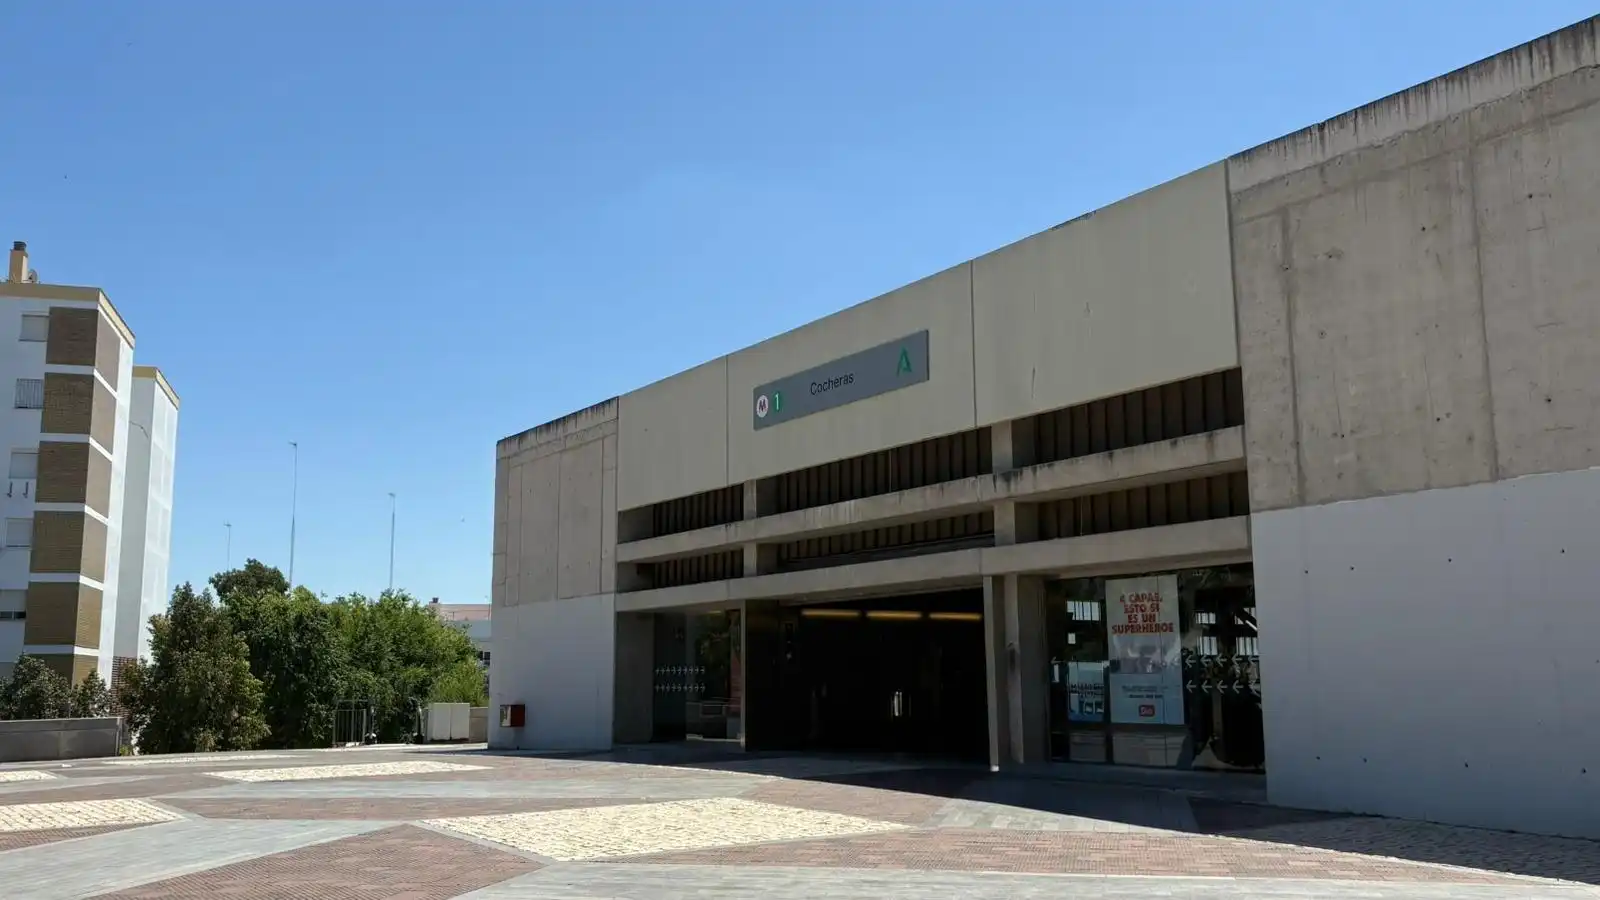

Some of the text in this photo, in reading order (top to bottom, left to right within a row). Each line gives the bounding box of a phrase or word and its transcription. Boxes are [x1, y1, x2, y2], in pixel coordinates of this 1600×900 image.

[810, 372, 854, 395] Cocheras
[1123, 603, 1147, 614] ESTO
[1127, 613, 1156, 624] ES UN
